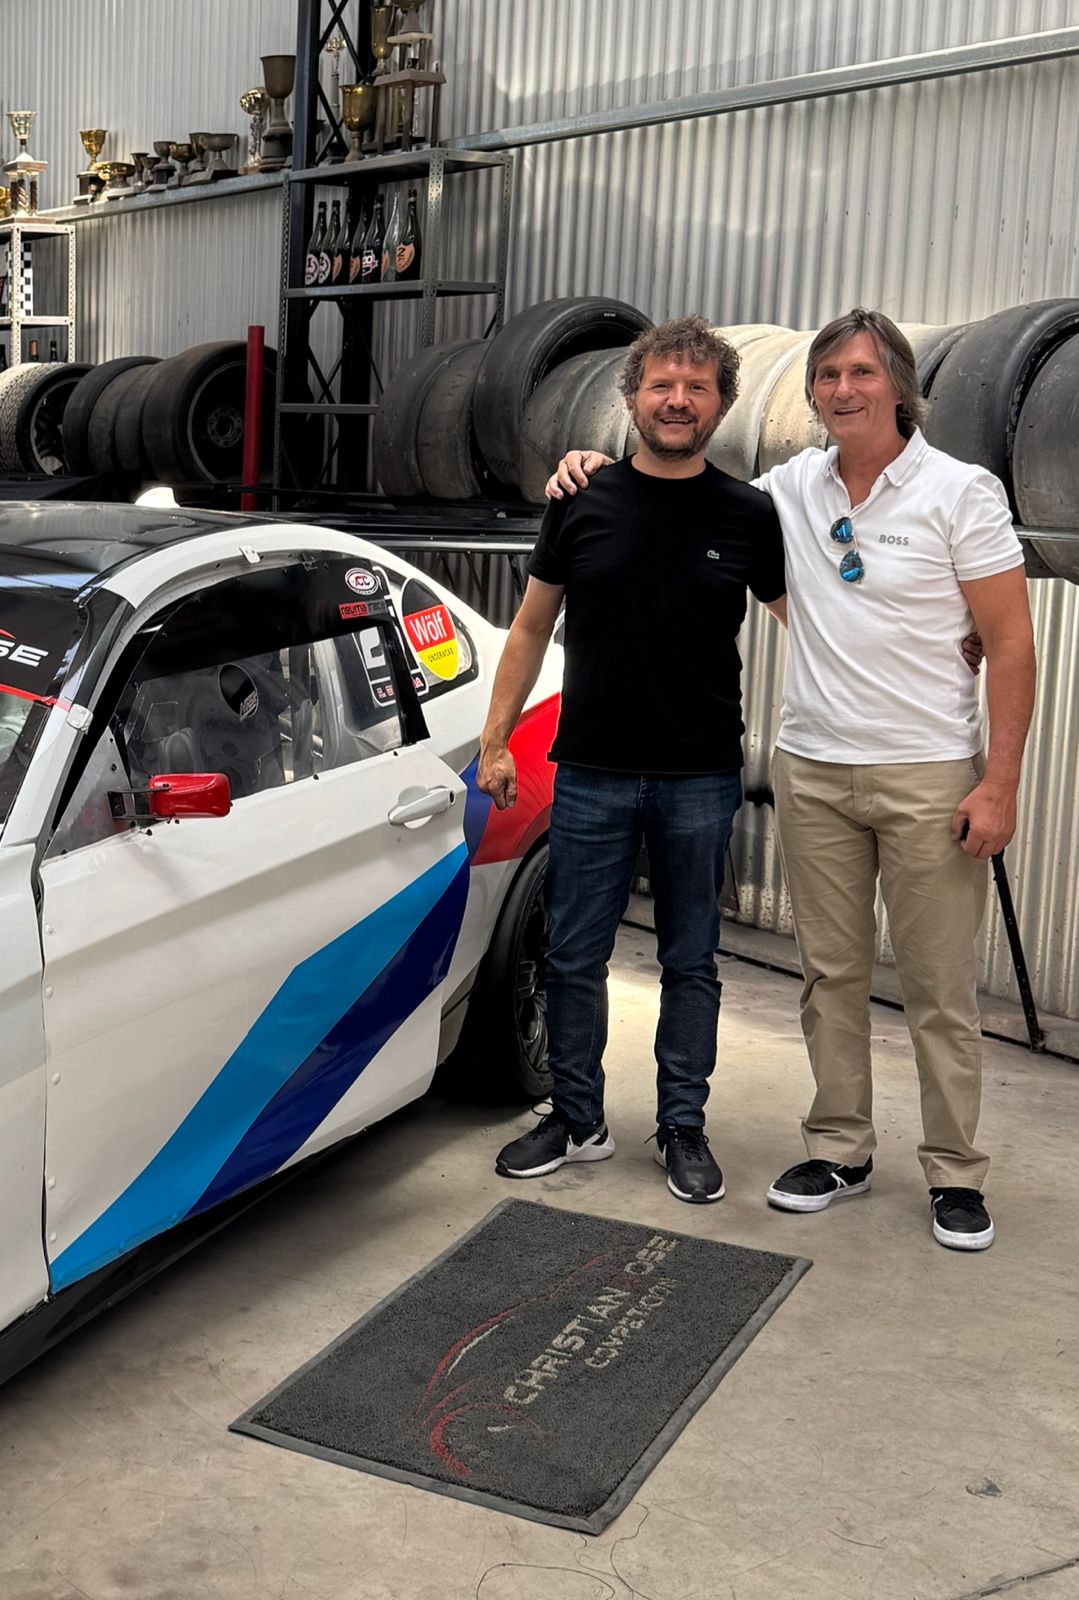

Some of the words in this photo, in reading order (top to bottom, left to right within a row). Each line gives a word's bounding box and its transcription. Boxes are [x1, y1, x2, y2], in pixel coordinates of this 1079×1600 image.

[879, 534, 909, 546] BOSS
[409, 610, 447, 646] Wölf
[503, 1286, 631, 1404] CHRISTIAN
